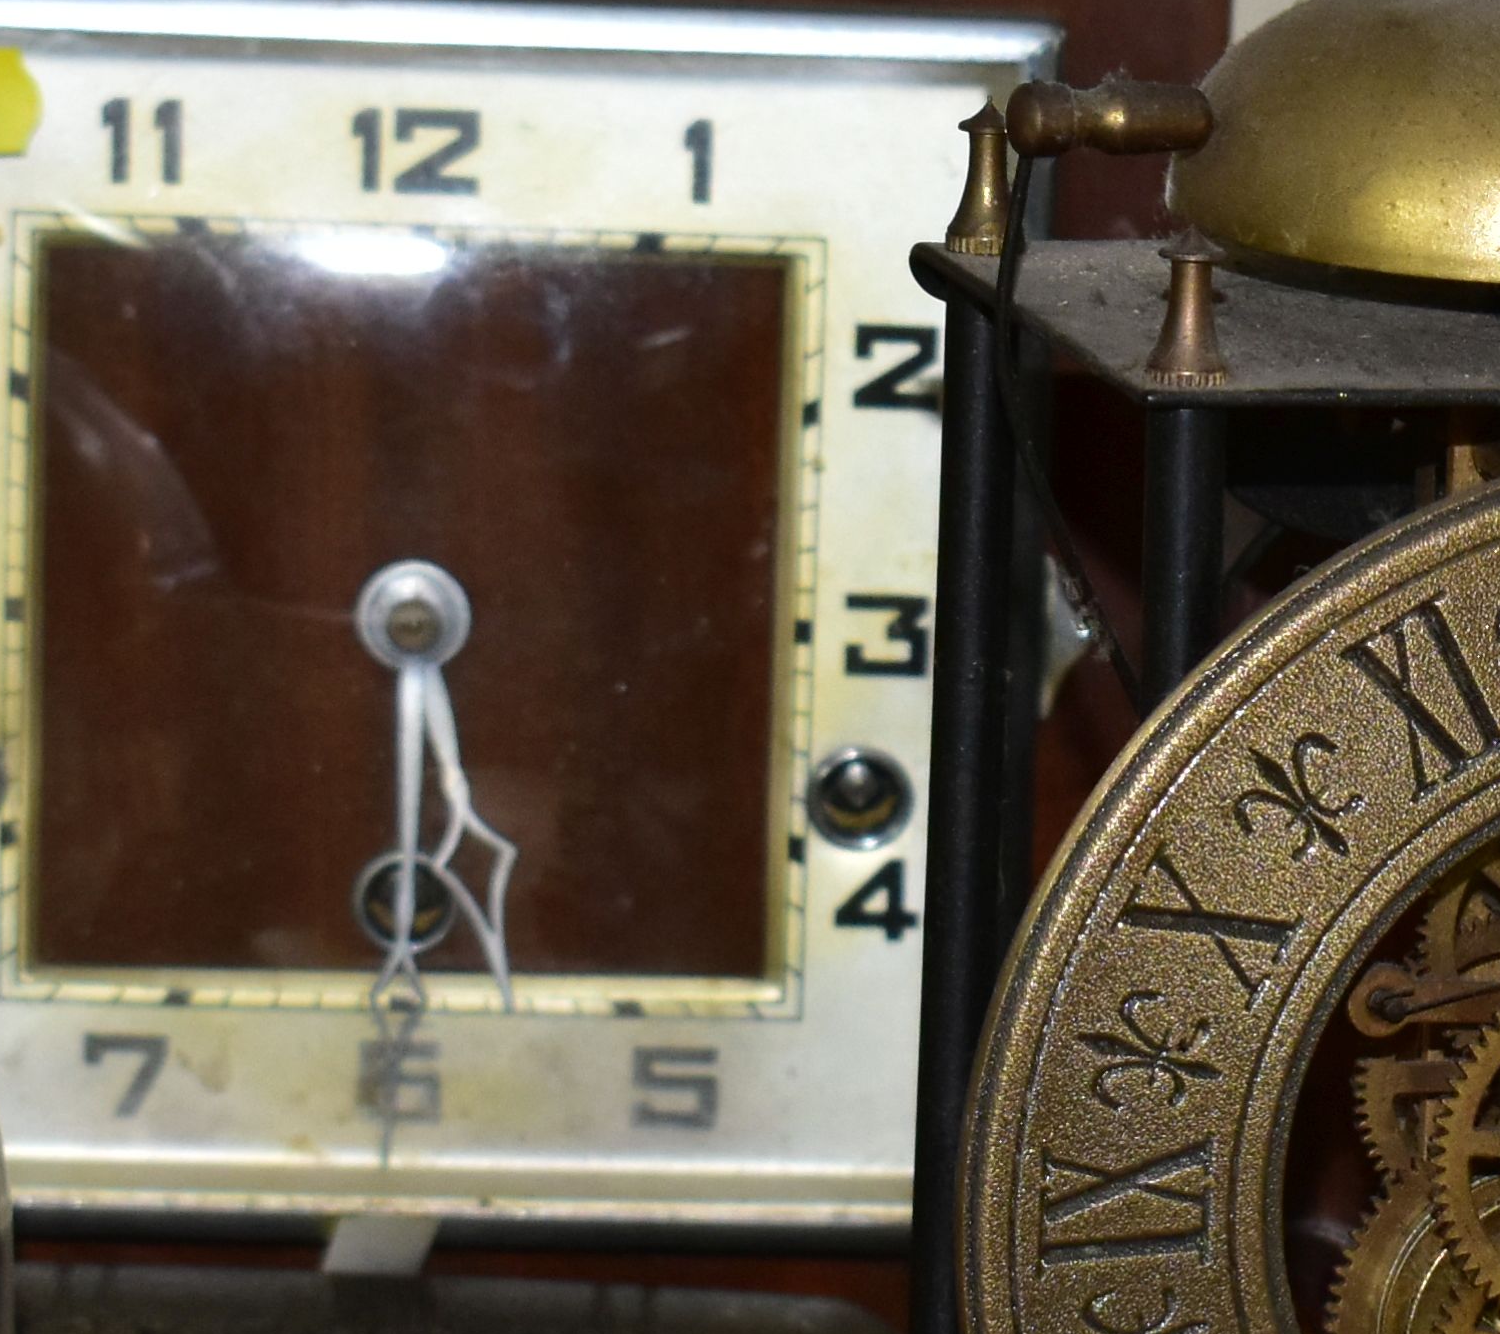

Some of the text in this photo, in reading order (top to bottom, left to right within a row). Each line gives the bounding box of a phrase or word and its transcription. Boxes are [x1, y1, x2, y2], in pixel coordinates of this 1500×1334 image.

[102, 97, 184, 185] 11
[352, 107, 481, 195] 12
[682, 118, 715, 204] 1
[854, 324, 940, 412] 2
[844, 594, 929, 677] 3
[835, 860, 919, 941] 4
[1112, 842, 1301, 1012] X
[85, 1034, 169, 1118] 7
[358, 1040, 442, 1124] 6
[631, 1048, 719, 1131] 5
[1040, 1130, 1215, 1279] IX
